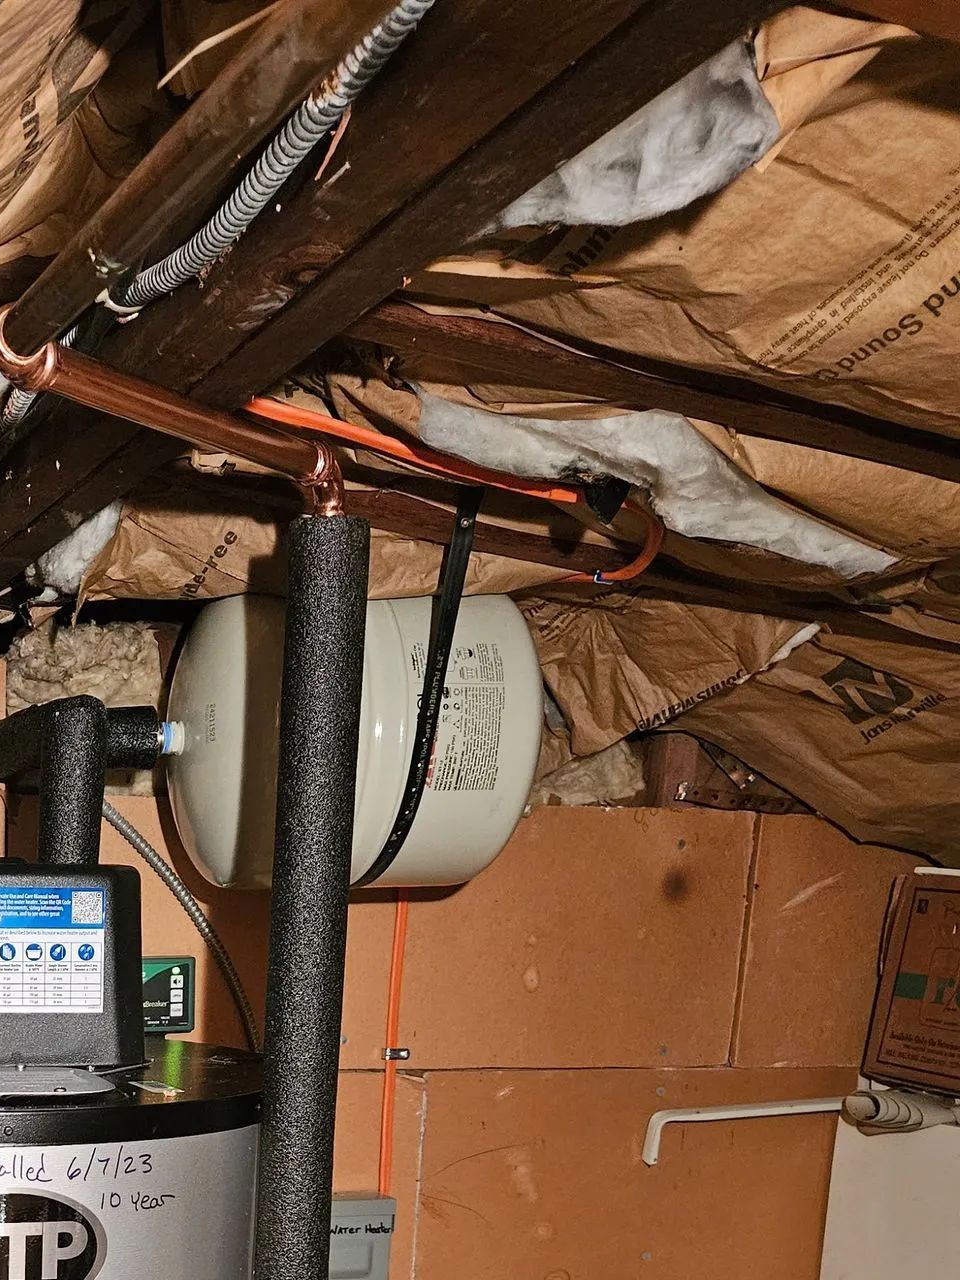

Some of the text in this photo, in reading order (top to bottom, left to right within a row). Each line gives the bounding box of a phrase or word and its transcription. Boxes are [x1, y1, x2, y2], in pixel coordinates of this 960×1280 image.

[900, 261, 914, 275] not
[841, 278, 874, 309] installed
[877, 273, 901, 295] leave
[921, 264, 960, 317] nd
[791, 320, 808, 335] heat
[835, 312, 925, 374] Sound
[66, 1145, 153, 1181] 6/7/23
[100, 1192, 121, 1210] 10
